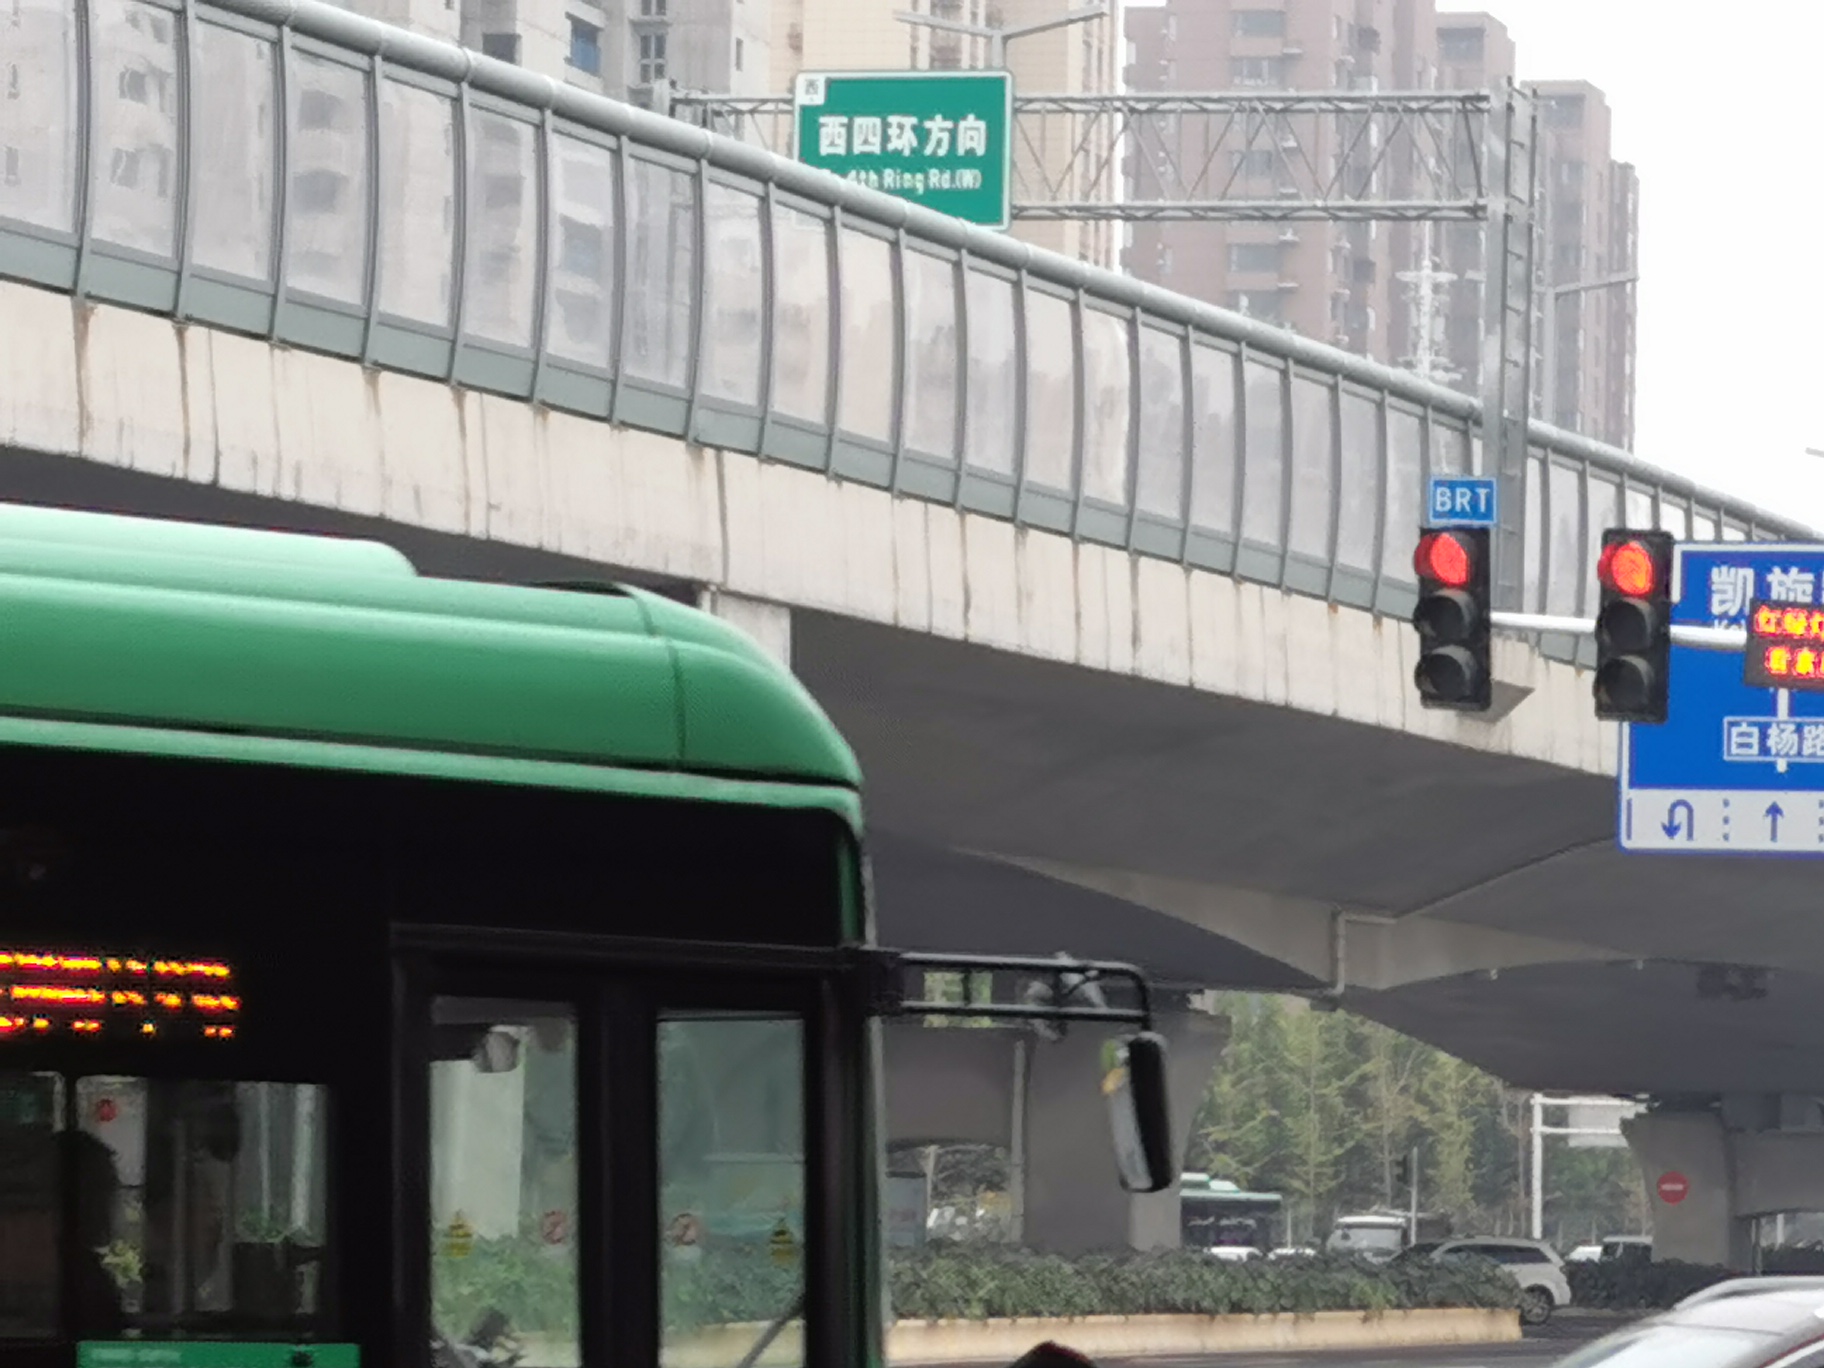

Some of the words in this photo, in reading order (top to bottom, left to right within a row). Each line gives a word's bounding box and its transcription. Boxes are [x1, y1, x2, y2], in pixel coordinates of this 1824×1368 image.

[818, 114, 987, 156] 西四环方向
[883, 169, 924, 194] Ring
[1435, 487, 1491, 513] BRT
